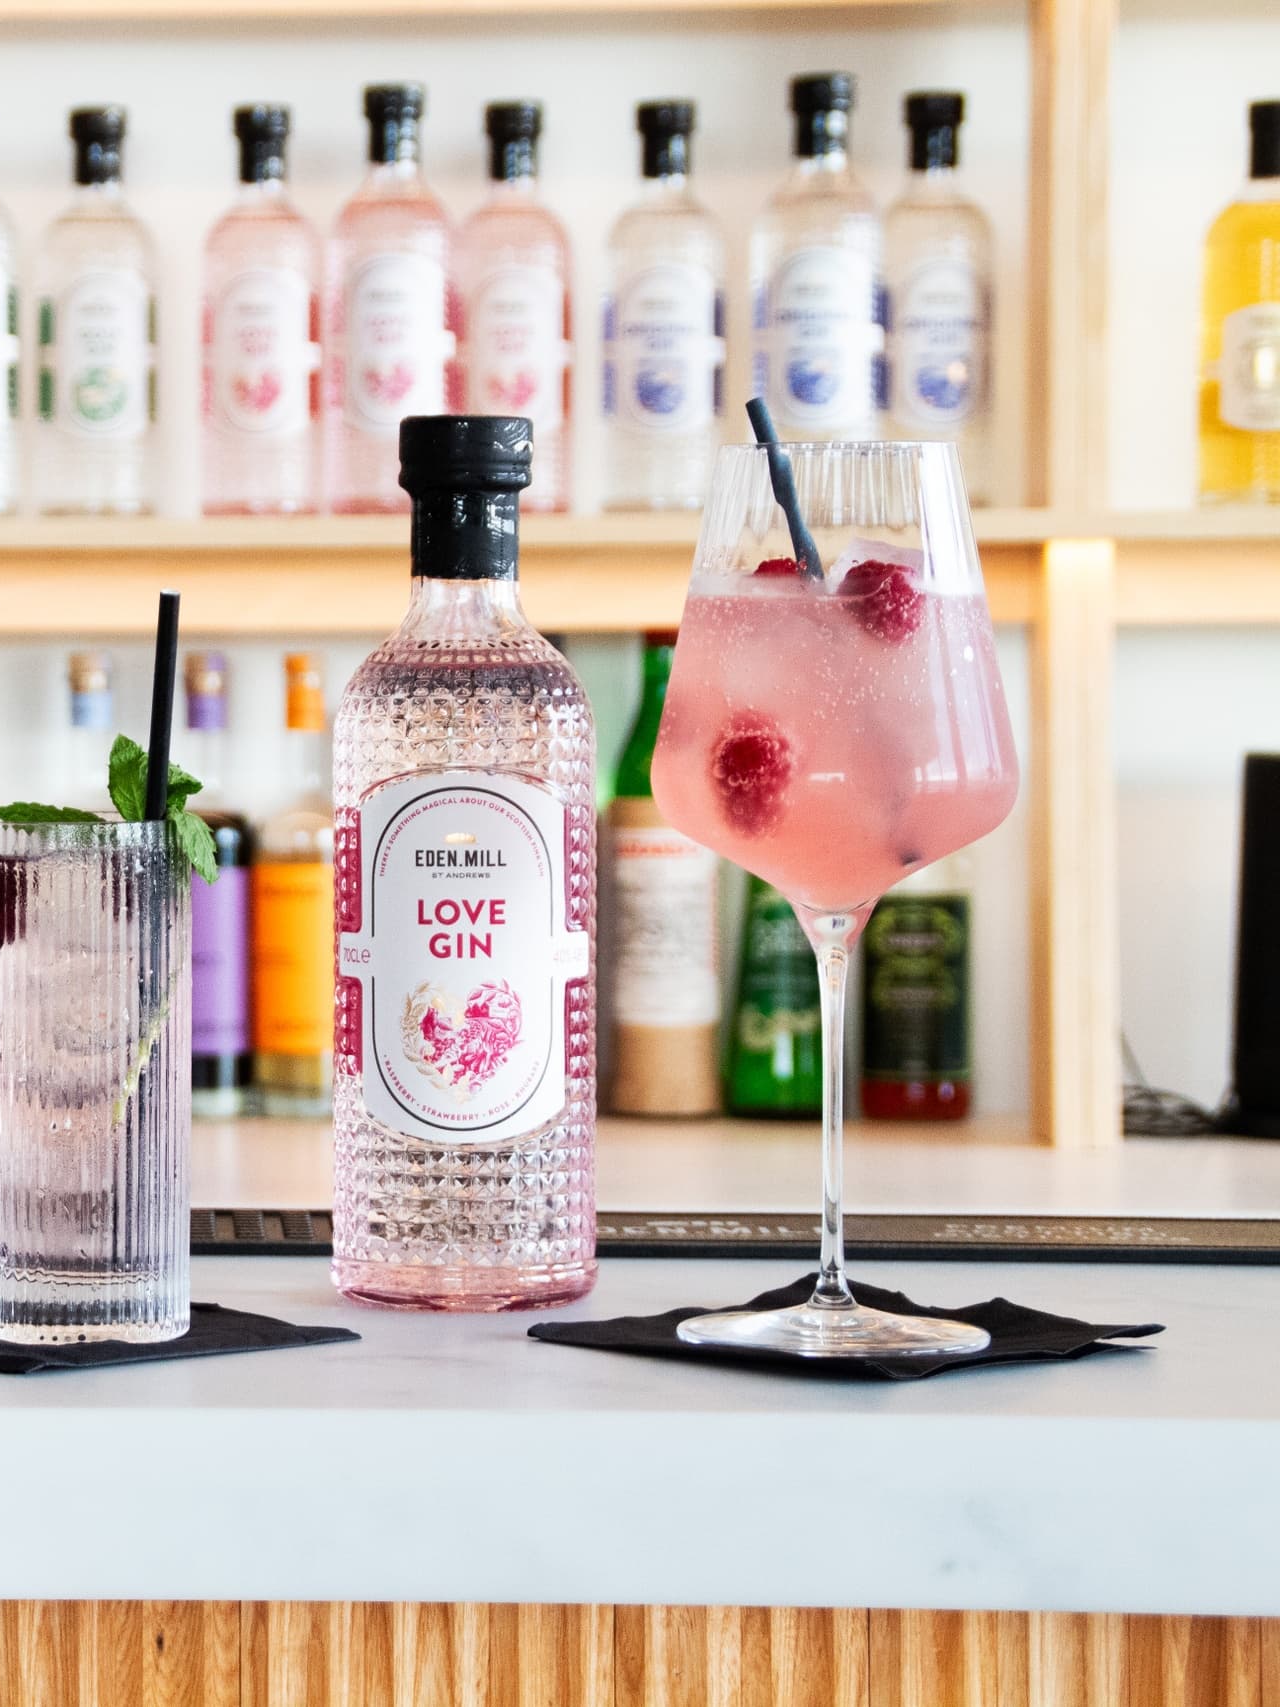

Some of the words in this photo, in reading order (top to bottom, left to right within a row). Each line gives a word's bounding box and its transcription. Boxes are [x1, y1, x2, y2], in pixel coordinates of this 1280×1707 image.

[388, 808, 421, 845] SOMETHING
[422, 798, 457, 812] MAGICAL
[459, 797, 487, 806] ABOUT
[488, 802, 506, 814] OUR
[506, 811, 533, 841] SCOTTISH
[415, 849, 508, 868] EDEN.MILL
[417, 898, 507, 926] LOVE
[429, 932, 492, 959] GIN
[385, 1060, 416, 1103] RASPBERRY
[421, 1104, 480, 1121] STRAWBERRY
[488, 1101, 510, 1115] ROSE
